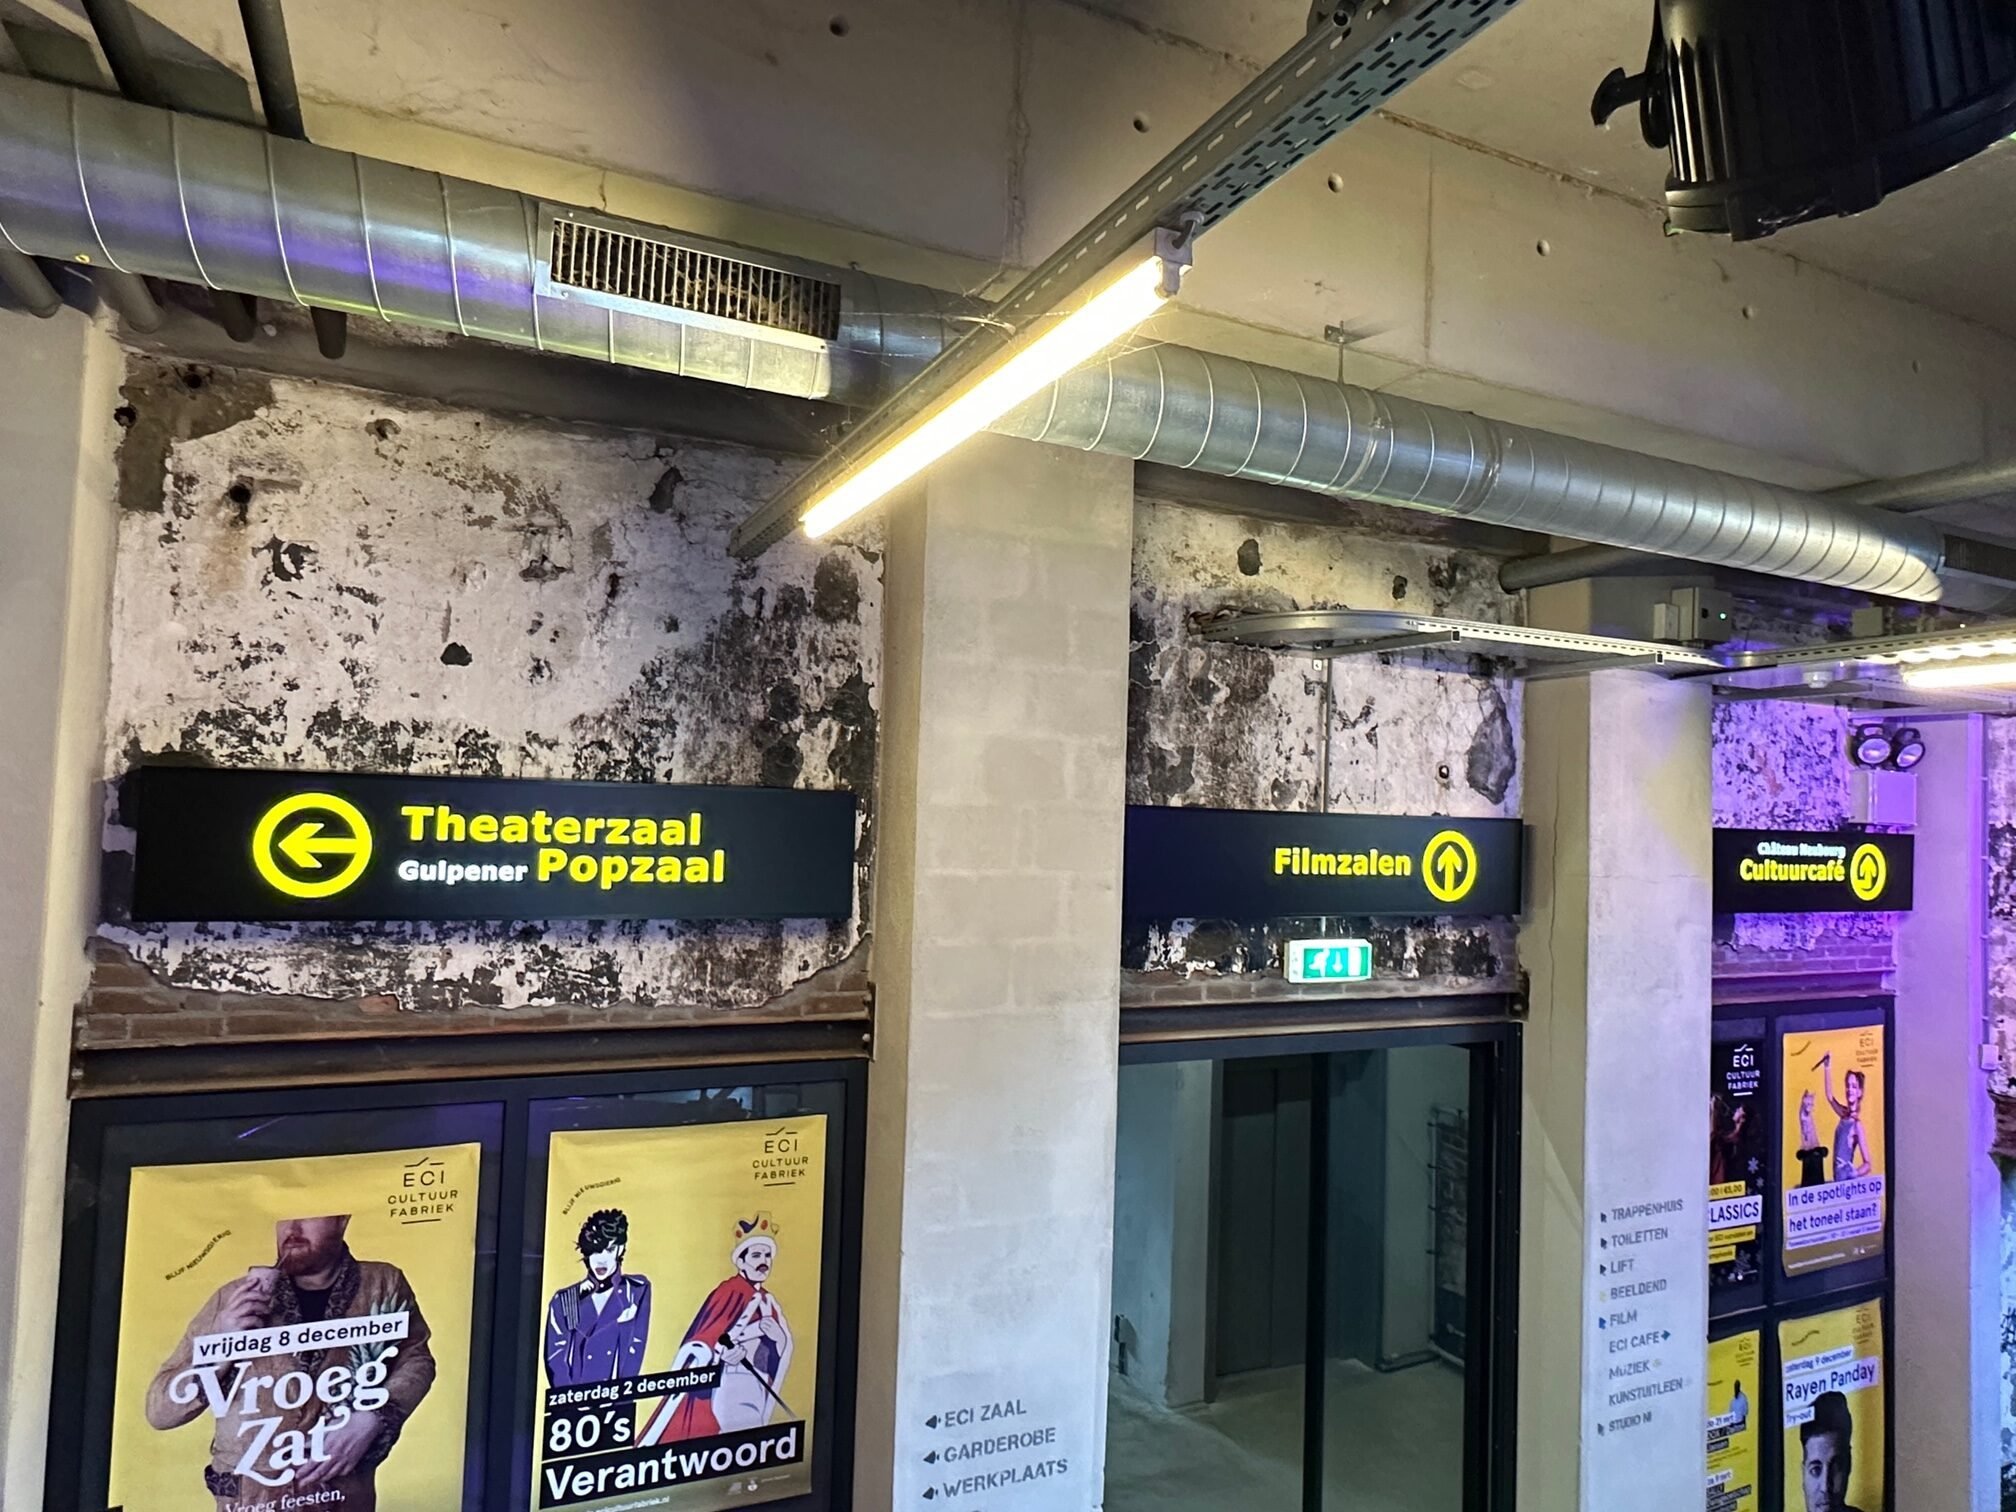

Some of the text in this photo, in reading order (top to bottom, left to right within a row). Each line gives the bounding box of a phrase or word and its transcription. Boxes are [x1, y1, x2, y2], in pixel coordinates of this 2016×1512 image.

[400, 805, 702, 847] Theaterzaal
[399, 847, 726, 890] Gulpener Popzaal
[1274, 847, 1412, 877] Filmzalen
[1740, 858, 1846, 882] Cultuurcafé
[1733, 1054, 1754, 1067] ECI
[1726, 1069, 1760, 1080] CULTUUR
[1728, 1081, 1759, 1090] FABRIEK
[764, 1139, 798, 1154] ECI
[752, 1156, 809, 1169] CULTUUR
[403, 1169, 446, 1188] ECI
[754, 1168, 806, 1181] FABRIEK
[387, 1189, 459, 1205] CULTUUR
[1788, 1181, 1882, 1206] In de spotlights op
[389, 1203, 455, 1218] FABRIEK
[1611, 1198, 1684, 1220] TRAPPENHUIS
[1710, 1202, 1759, 1223] LASSICS
[1789, 1202, 1877, 1232] het toneel staan?
[1611, 1227, 1668, 1247] TOILETTEN
[1610, 1258, 1635, 1274] LIFT
[1610, 1279, 1667, 1300] BEELDEND
[1609, 1309, 1637, 1327] FILM
[199, 1317, 403, 1360] vrijdag 8 december
[1609, 1331, 1660, 1353] ECI CAFE
[168, 1345, 400, 1418] Vroeg
[549, 1370, 716, 1406] zaterdag 2 december
[1609, 1377, 1683, 1407] KUNSTUITLEEN
[1786, 1364, 1875, 1402] Rayen Panday
[944, 1399, 1027, 1428] ECI ZAAL
[549, 1411, 632, 1453] 80's
[233, 1405, 354, 1487] Zat
[944, 1427, 1056, 1463] GARDEROBE
[545, 1429, 797, 1500] Verantwoord
[943, 1459, 1068, 1498] WERKPLAATS
[280, 1489, 346, 1510] feesten,
